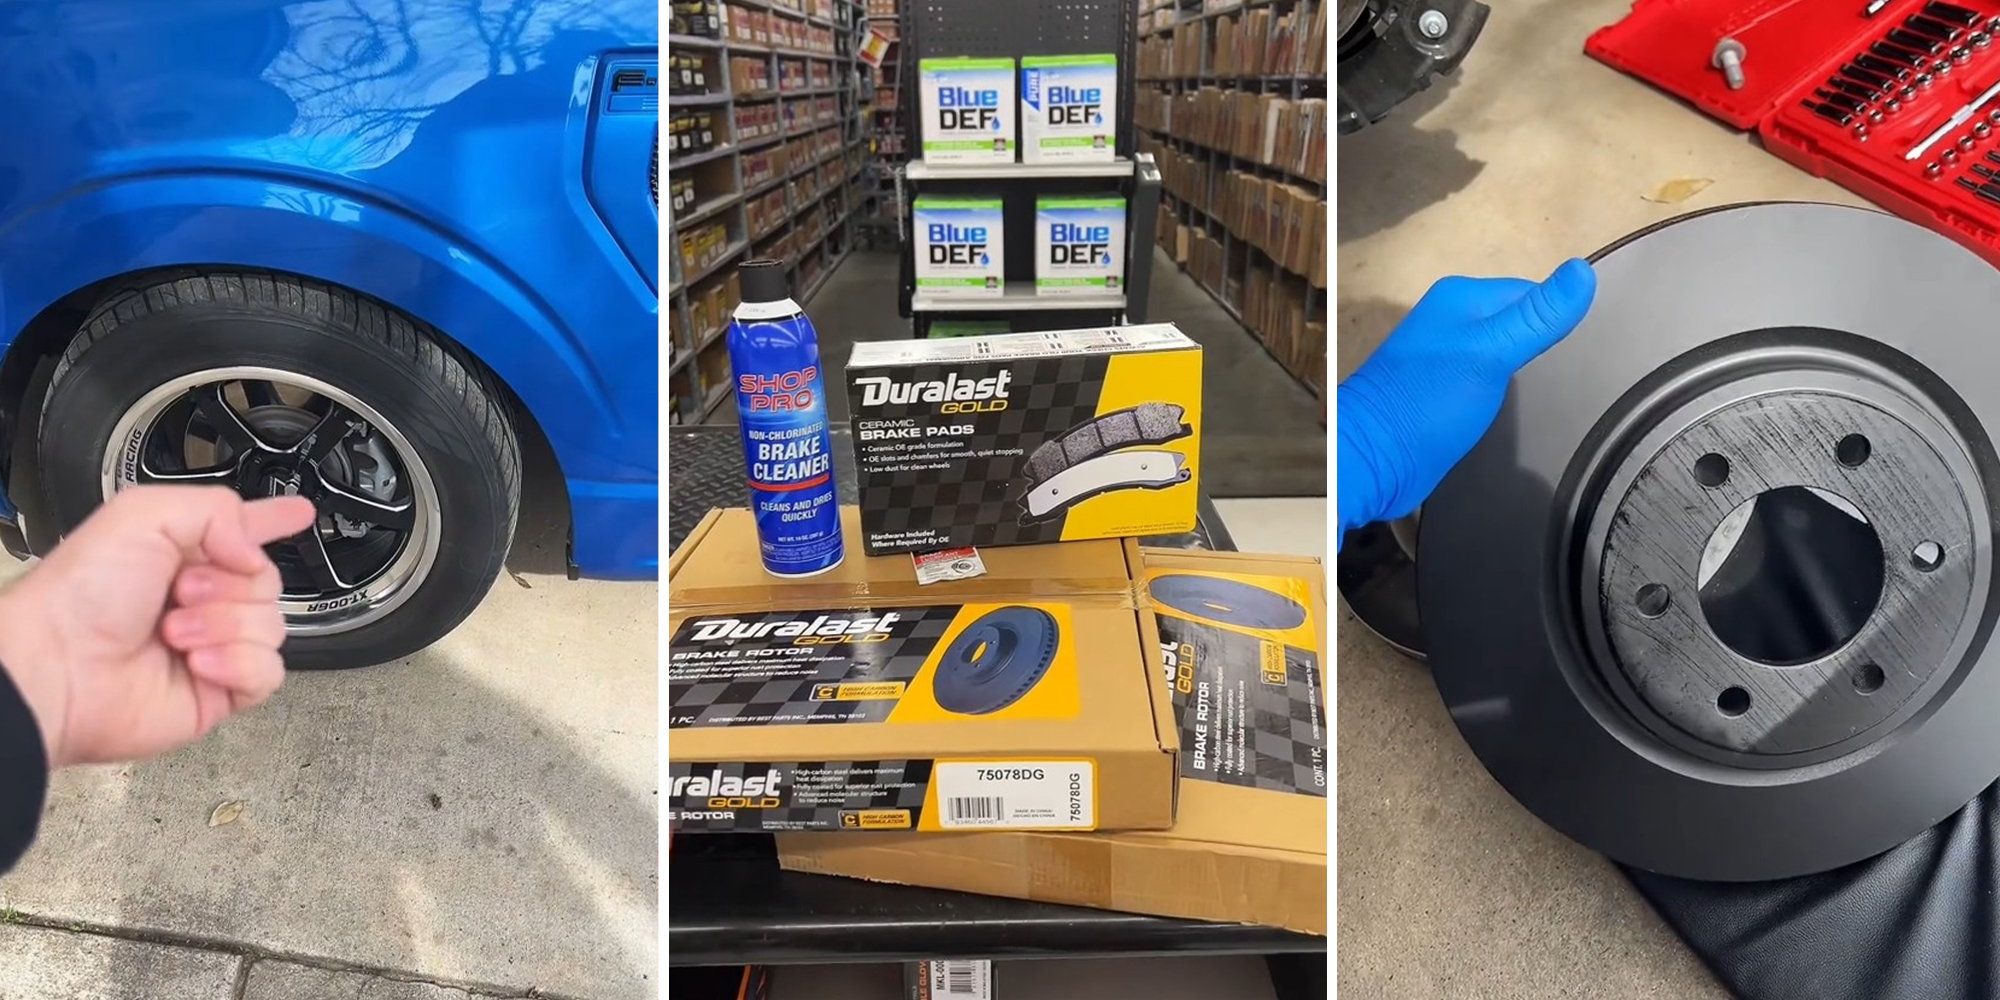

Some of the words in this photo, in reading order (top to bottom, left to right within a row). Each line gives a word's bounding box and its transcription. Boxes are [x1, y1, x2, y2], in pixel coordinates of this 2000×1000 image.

[938, 87, 998, 107] Blue
[1048, 86, 1101, 104] Blue
[939, 108, 997, 130] DEF
[1048, 105, 1101, 125] DEF
[929, 223, 987, 243] Blue
[1050, 223, 1109, 243] Blue
[929, 244, 987, 265] DEF
[1050, 244, 1109, 265] DEF
[739, 365, 817, 393] SHOP
[854, 369, 1011, 406] Duralast
[750, 388, 814, 412] PRO
[940, 399, 1008, 414] GOLD
[748, 421, 824, 441] NON-CHLORINATED
[859, 419, 915, 430] CERAMIC
[860, 427, 921, 440] BRAKE
[926, 424, 975, 437] PADS
[125, 428, 142, 483] RACING
[758, 435, 820, 461] BRAKE
[867, 445, 895, 453] Ceramic
[907, 443, 927, 451] grade
[927, 440, 964, 449] formulation
[868, 455, 880, 463] OE
[880, 454, 896, 462] slots
[897, 453, 909, 461] and
[910, 452, 939, 460] chamfers
[940, 451, 950, 459] for
[977, 449, 994, 457] quiet
[995, 447, 1024, 456] stopping
[753, 453, 829, 481] CLEANER
[884, 464, 899, 472] dust
[899, 463, 910, 471] for
[910, 462, 928, 470] clean
[928, 461, 950, 469] wheels
[760, 501, 791, 512] CLEANS
[792, 499, 811, 511] AND
[813, 491, 832, 506] DRIES
[781, 508, 818, 522] QUICKLY
[871, 532, 905, 541] Hardware
[906, 530, 935, 538] Included
[871, 540, 895, 548] Where
[896, 538, 927, 547] Required
[928, 537, 937, 545] By
[690, 612, 900, 641] Duralast
[793, 633, 890, 645] GOLD
[671, 650, 741, 660] BRAKE
[745, 647, 815, 657] ROTOR
[1177, 643, 1195, 694] GOLD
[1197, 681, 1210, 721] ROTOR
[670, 716, 676, 724] 1
[678, 716, 696, 724] PC.
[1193, 724, 1208, 770] BRAKE
[1311, 746, 1321, 758] PC.
[669, 769, 782, 797] ralast
[977, 769, 1045, 781] 75078DG
[1313, 765, 1325, 787] CONT.
[708, 797, 780, 808] GOLD
[1069, 773, 1081, 821] 75078DG
[680, 811, 735, 820] ROTOR
